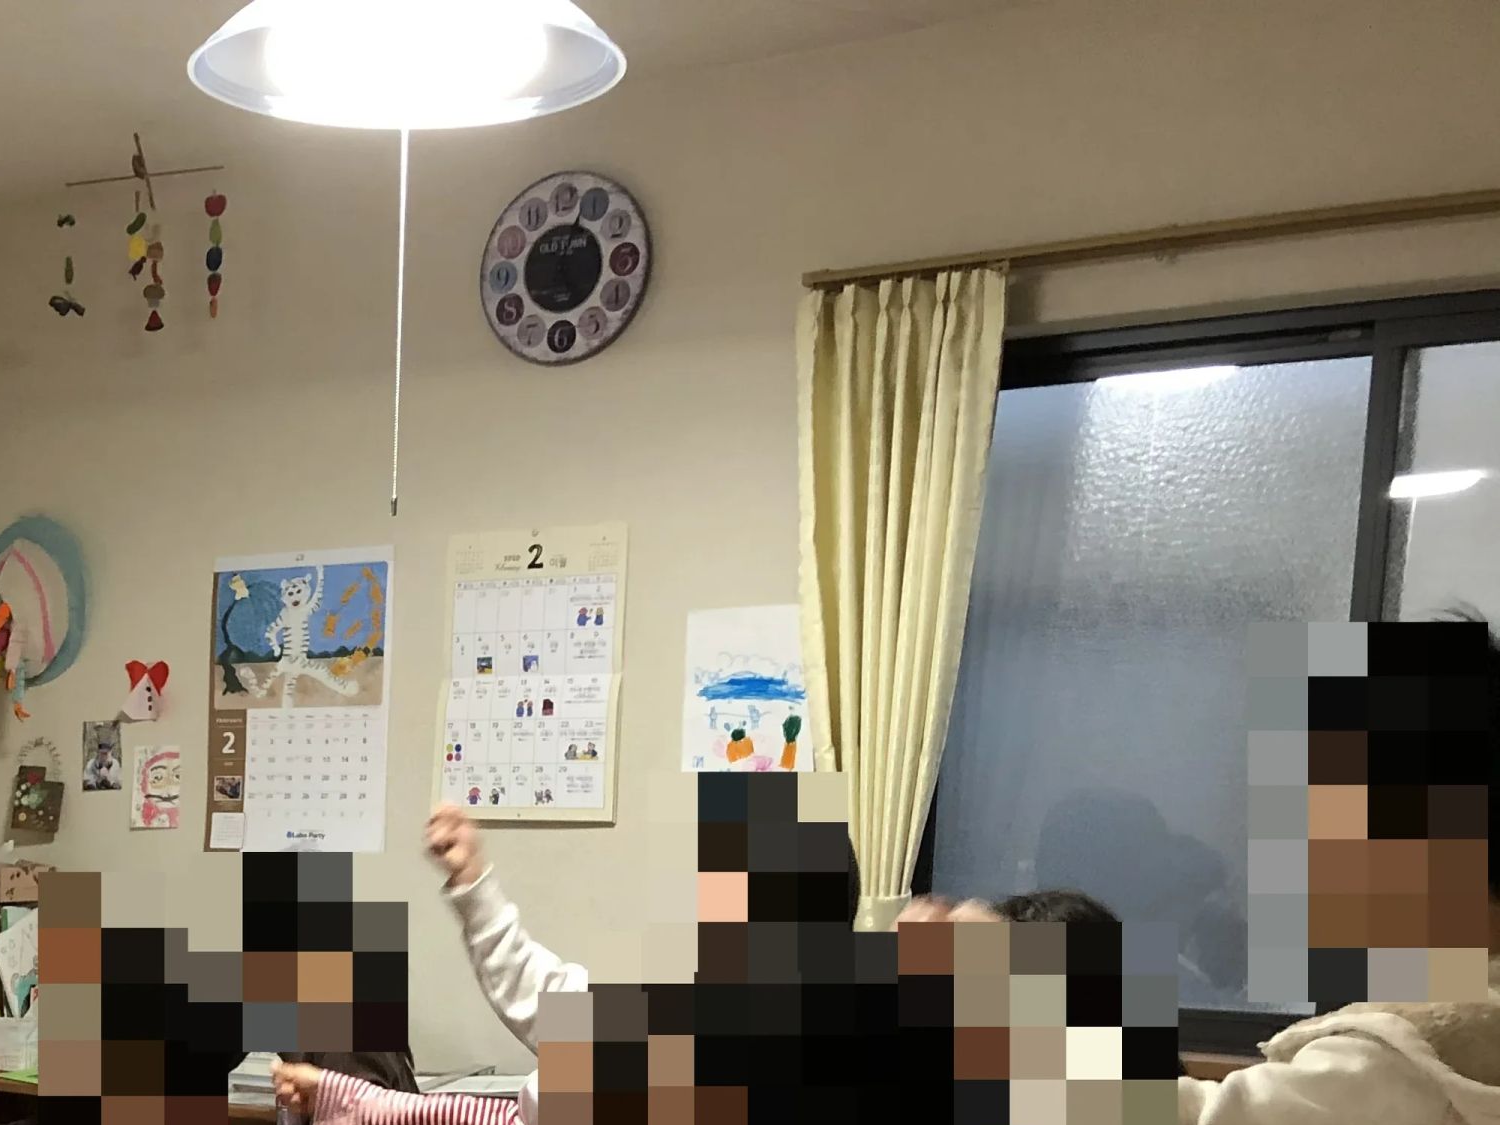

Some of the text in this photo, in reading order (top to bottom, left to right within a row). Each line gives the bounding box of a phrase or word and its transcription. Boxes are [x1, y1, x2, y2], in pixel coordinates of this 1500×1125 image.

[502, 300, 518, 321] 8
[553, 326, 569, 350] 6
[527, 543, 544, 569] 2
[222, 731, 235, 754] 2
